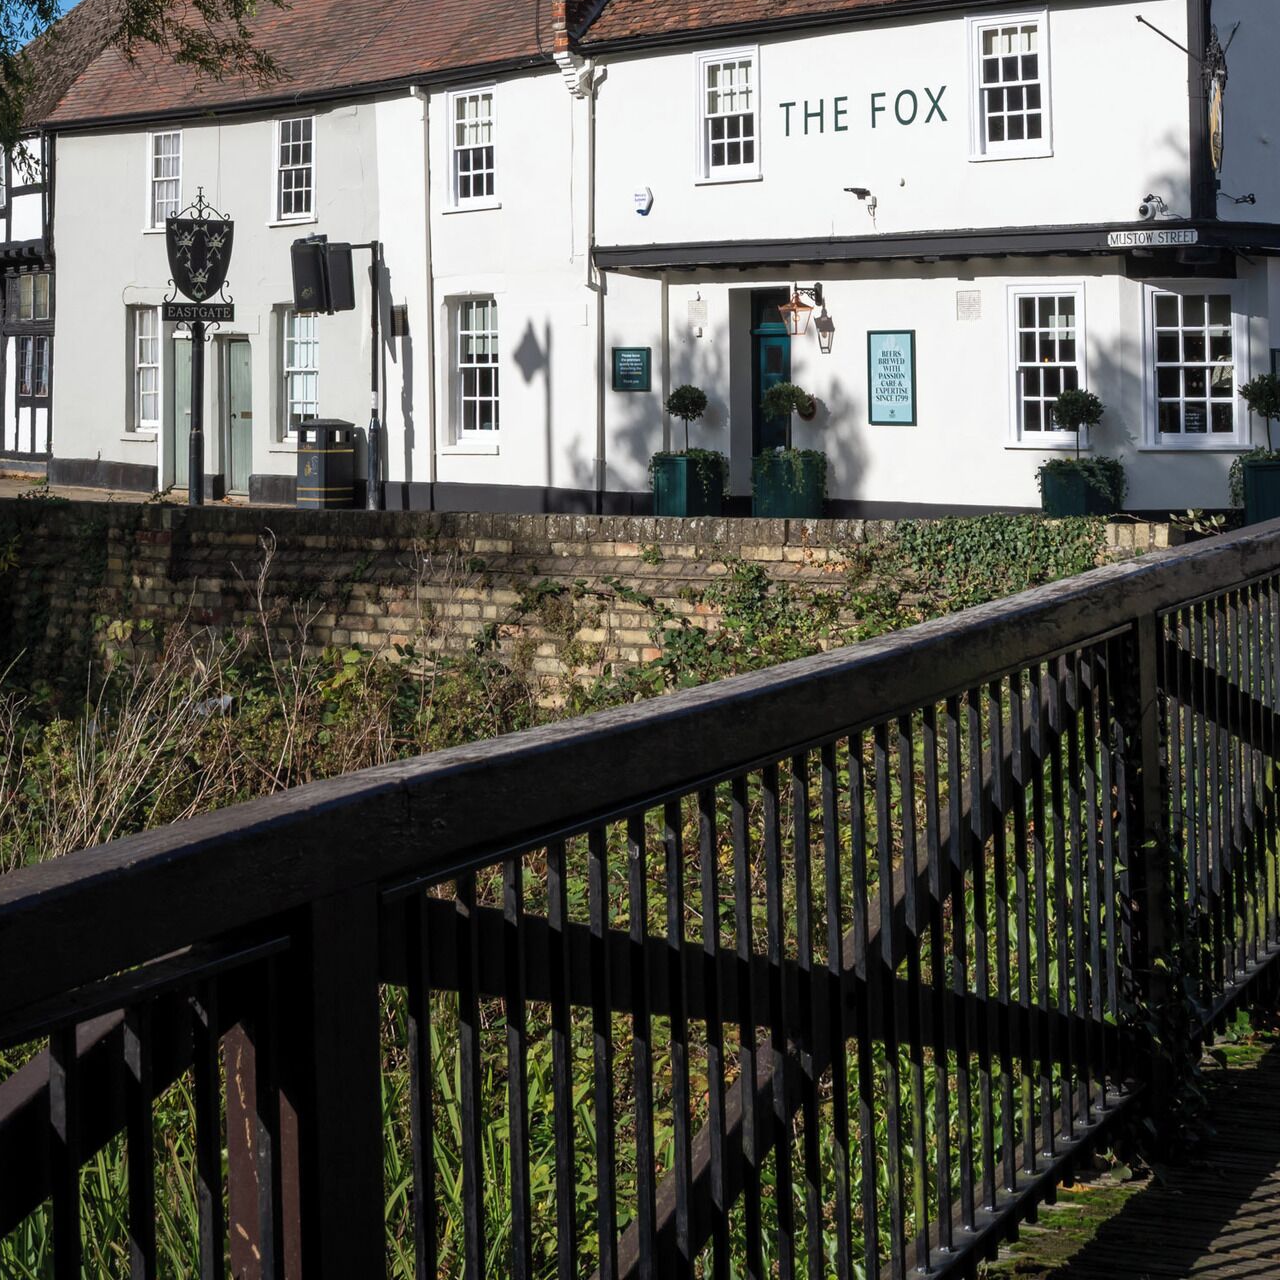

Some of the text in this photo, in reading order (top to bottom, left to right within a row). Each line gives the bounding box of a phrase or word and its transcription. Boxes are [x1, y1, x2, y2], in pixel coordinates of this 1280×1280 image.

[779, 85, 948, 137] THE FOX
[1110, 231, 1196, 245] MUSTOW STREET
[167, 306, 231, 318] EASTGATE
[881, 350, 902, 358] BEERS
[878, 372, 905, 380] PASSION
[876, 387, 908, 395] EXPERTISE
[895, 394, 908, 402] 1799
